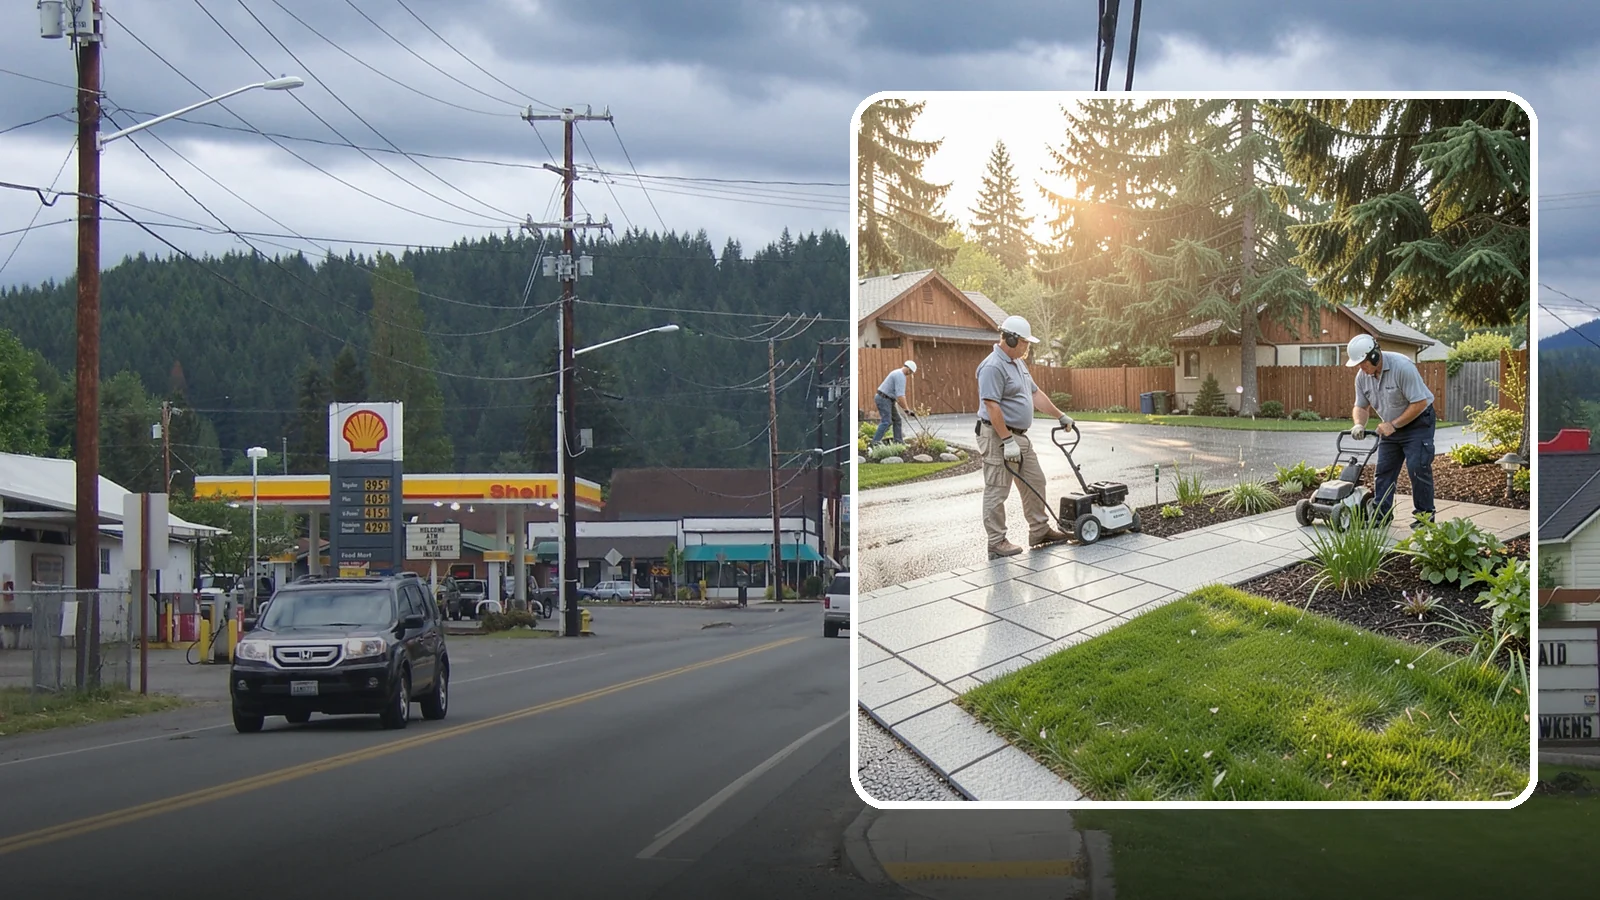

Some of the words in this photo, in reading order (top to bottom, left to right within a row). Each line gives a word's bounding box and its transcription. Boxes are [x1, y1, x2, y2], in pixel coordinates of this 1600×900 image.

[342, 482, 358, 490] Regular
[366, 480, 383, 490] 395
[490, 484, 547, 499] Shell
[366, 494, 383, 504] 405
[366, 508, 383, 518] 415
[366, 523, 383, 533] 429
[1538, 643, 1567, 665] AID
